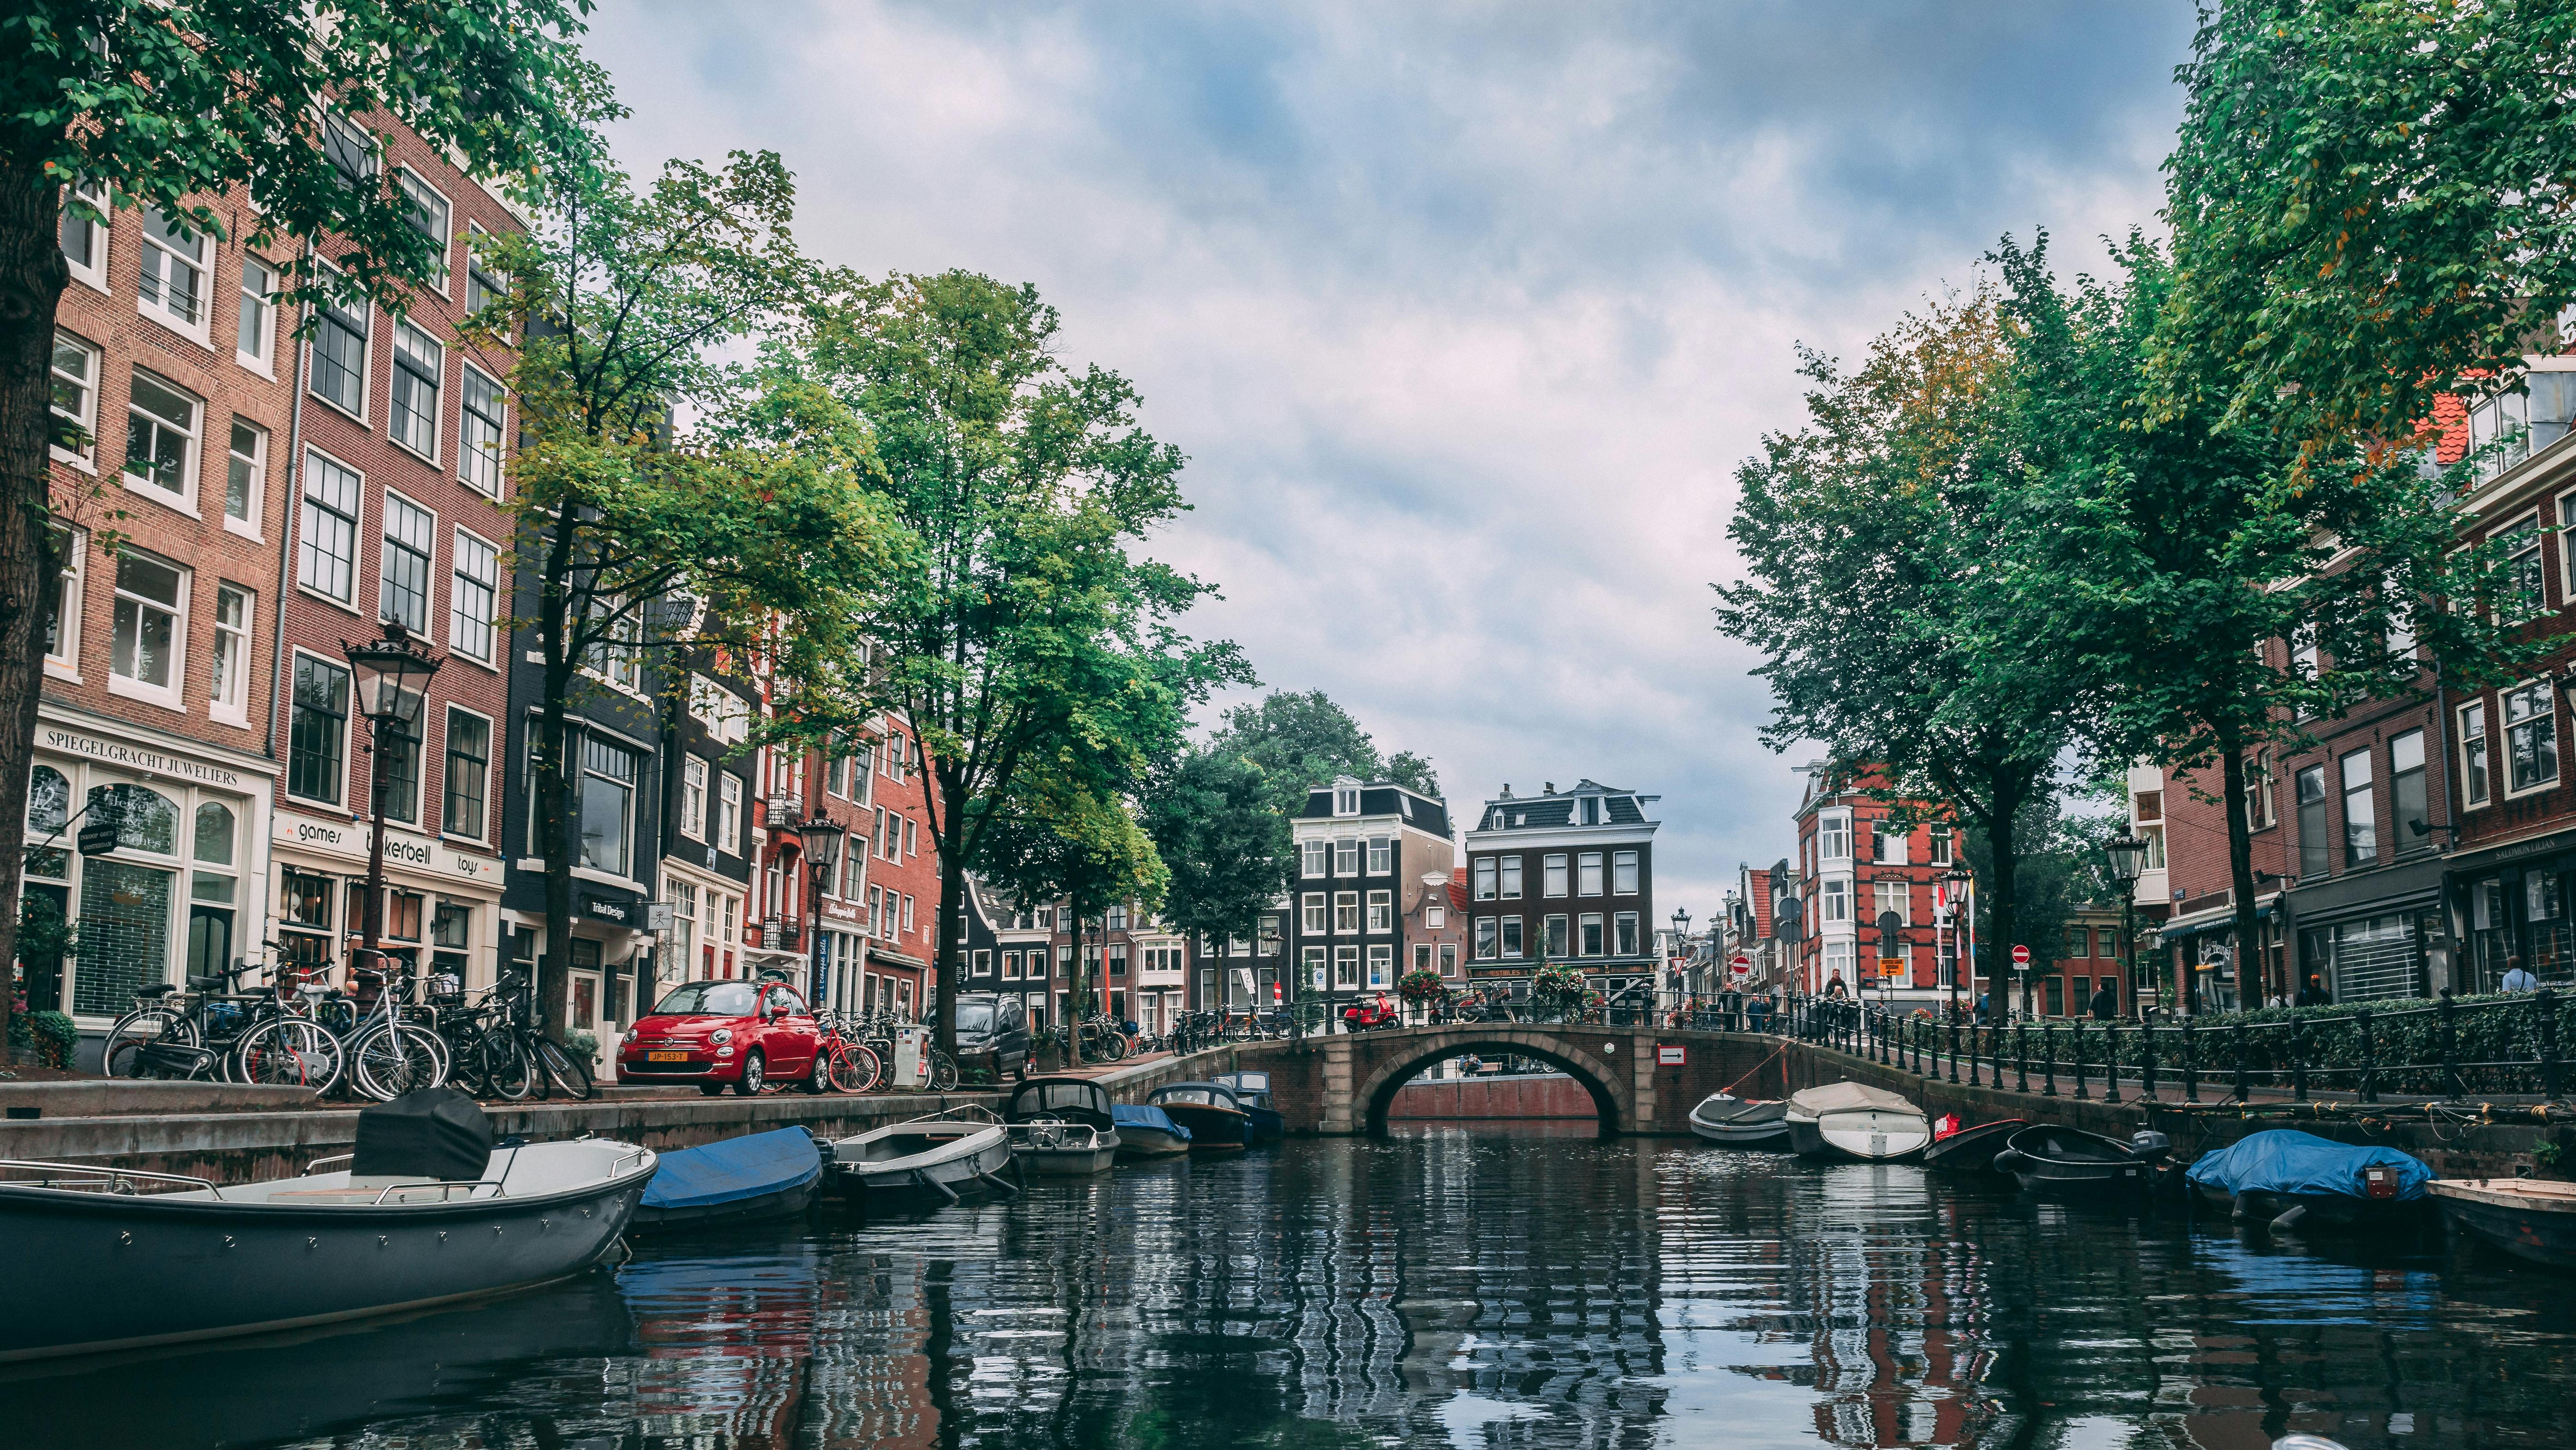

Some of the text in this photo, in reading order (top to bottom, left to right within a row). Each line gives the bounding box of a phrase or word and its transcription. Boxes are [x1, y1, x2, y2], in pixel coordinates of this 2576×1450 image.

[48, 731, 237, 786] SPIEGELGRACHT JUWELIERS
[30, 782, 55, 811] 12
[111, 795, 156, 814] Jewels
[117, 833, 161, 848] atches
[299, 824, 341, 844] games
[366, 831, 431, 865] tkerbell
[2496, 838, 2555, 860] SALOMON LILIAN
[458, 855, 478, 875] toys
[592, 902, 624, 920] Tribal Design
